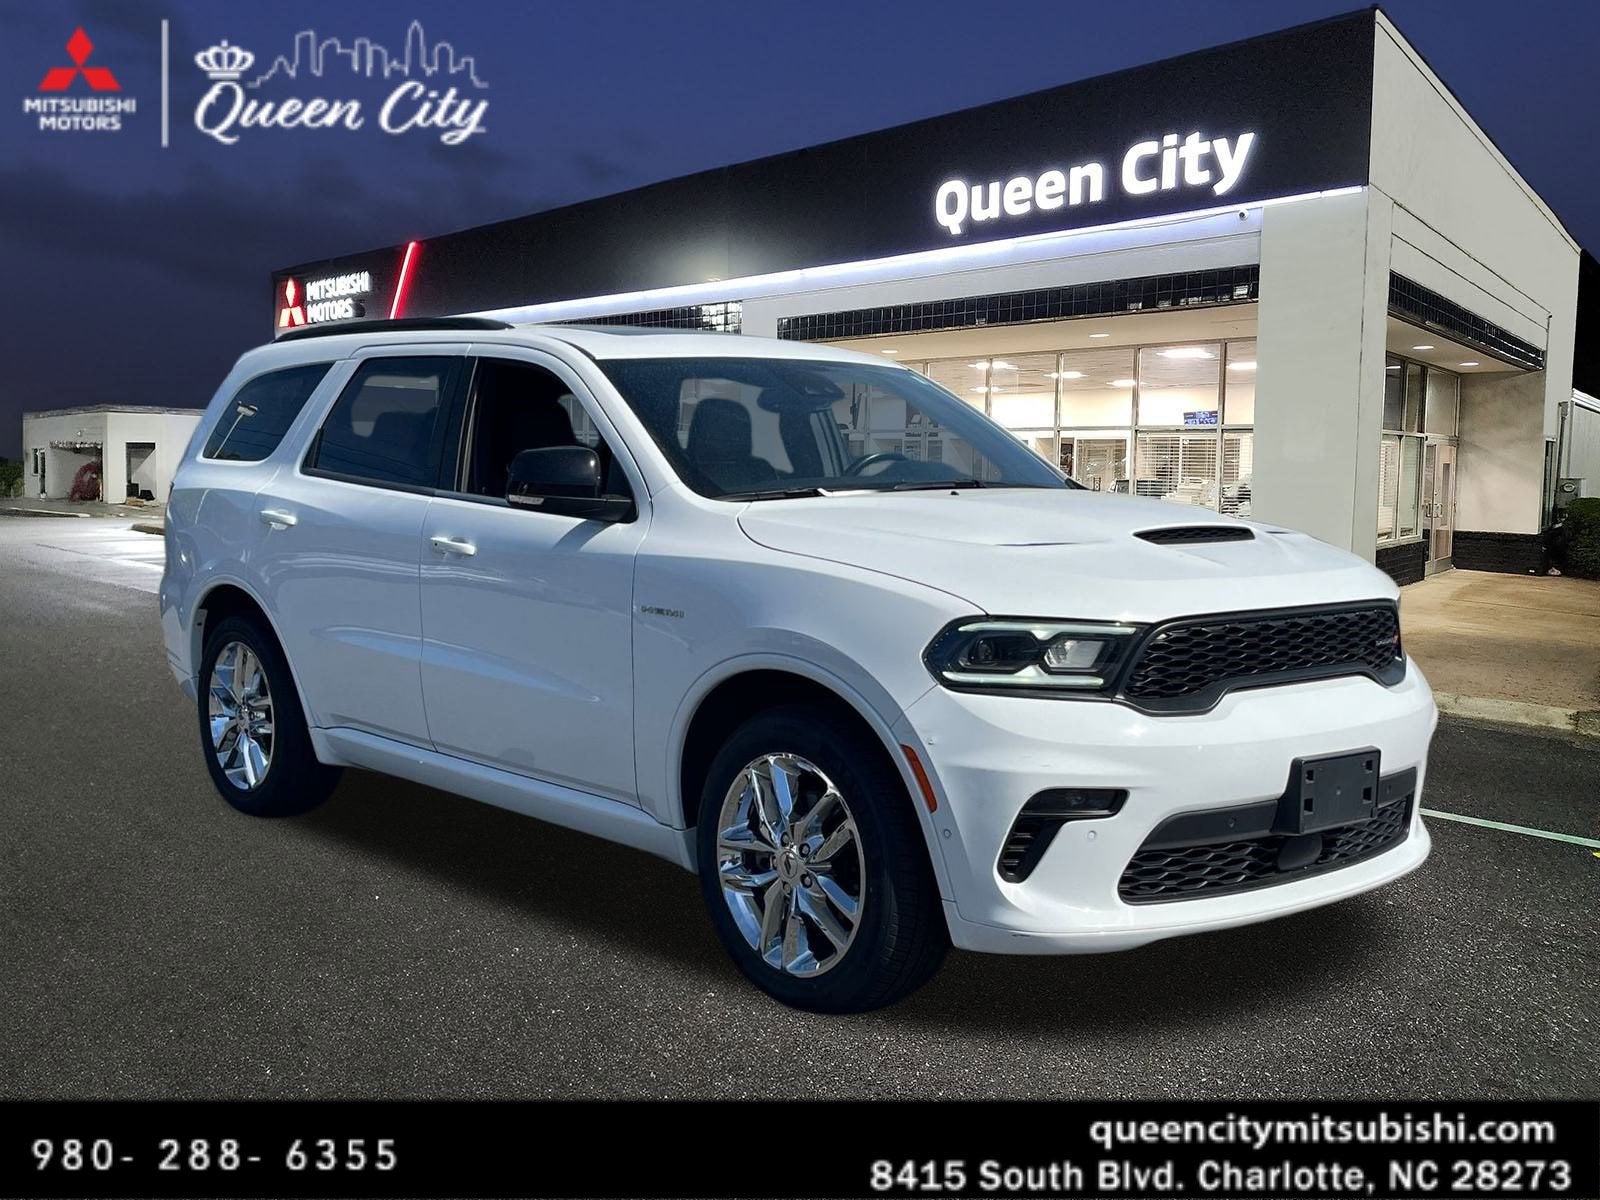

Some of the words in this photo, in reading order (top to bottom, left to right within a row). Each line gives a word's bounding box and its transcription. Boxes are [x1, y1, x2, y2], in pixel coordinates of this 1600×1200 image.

[934, 160, 1104, 235] Queen
[1121, 131, 1256, 196] City
[306, 271, 371, 301] MITSUBISHI
[306, 298, 354, 324] MOTORS
